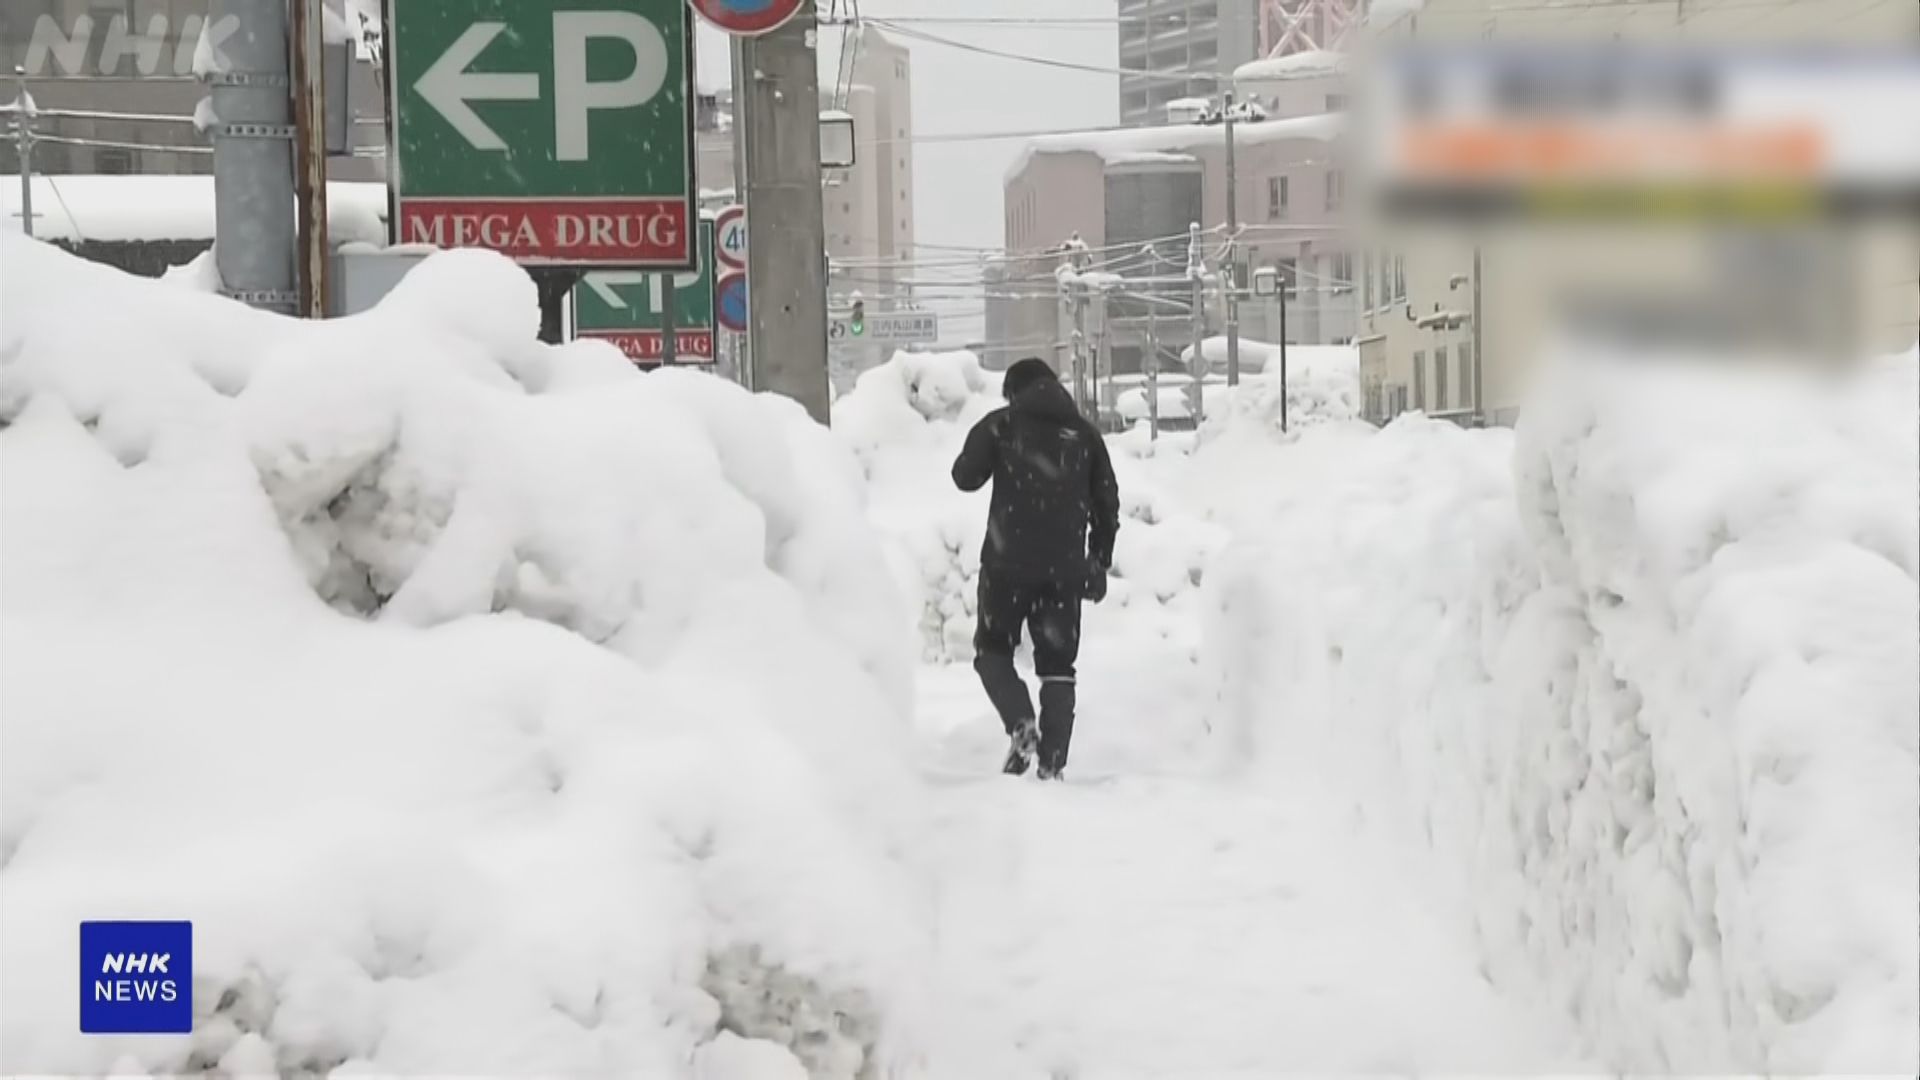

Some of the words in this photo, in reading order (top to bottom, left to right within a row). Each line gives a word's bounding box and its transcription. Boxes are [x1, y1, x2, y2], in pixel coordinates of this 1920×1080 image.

[552, 10, 669, 161] P
[409, 213, 542, 248] MEGA
[552, 213, 678, 248] DRUG
[725, 226, 745, 252] 4
[650, 336, 708, 354] DUG
